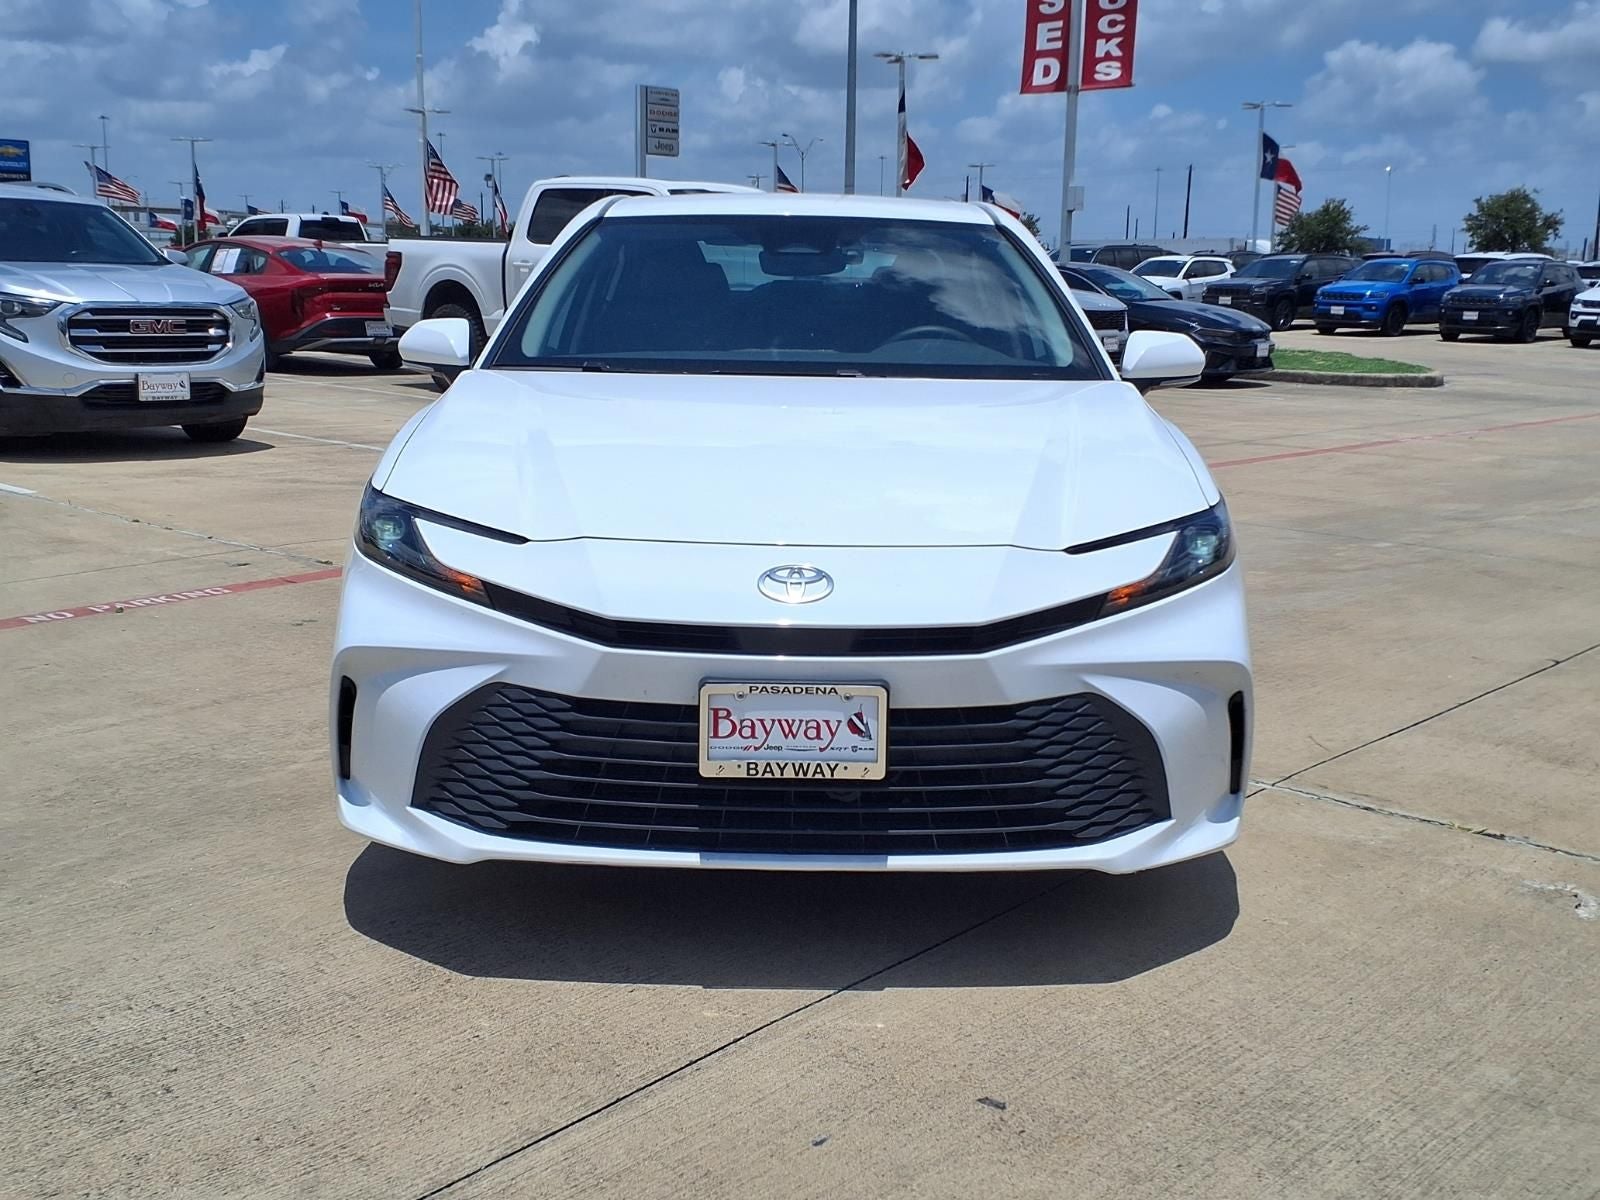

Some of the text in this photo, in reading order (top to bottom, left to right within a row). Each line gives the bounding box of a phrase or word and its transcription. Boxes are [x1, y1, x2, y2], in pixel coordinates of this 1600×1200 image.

[654, 139, 674, 152] Jeep
[129, 320, 187, 334] GMC
[142, 380, 179, 391] Bayway
[20, 587, 233, 623] NO PARKING
[748, 685, 839, 695] PASADENA
[709, 707, 842, 752] Bayway
[763, 744, 783, 752] Jeep
[746, 762, 840, 777] BAYWAY
